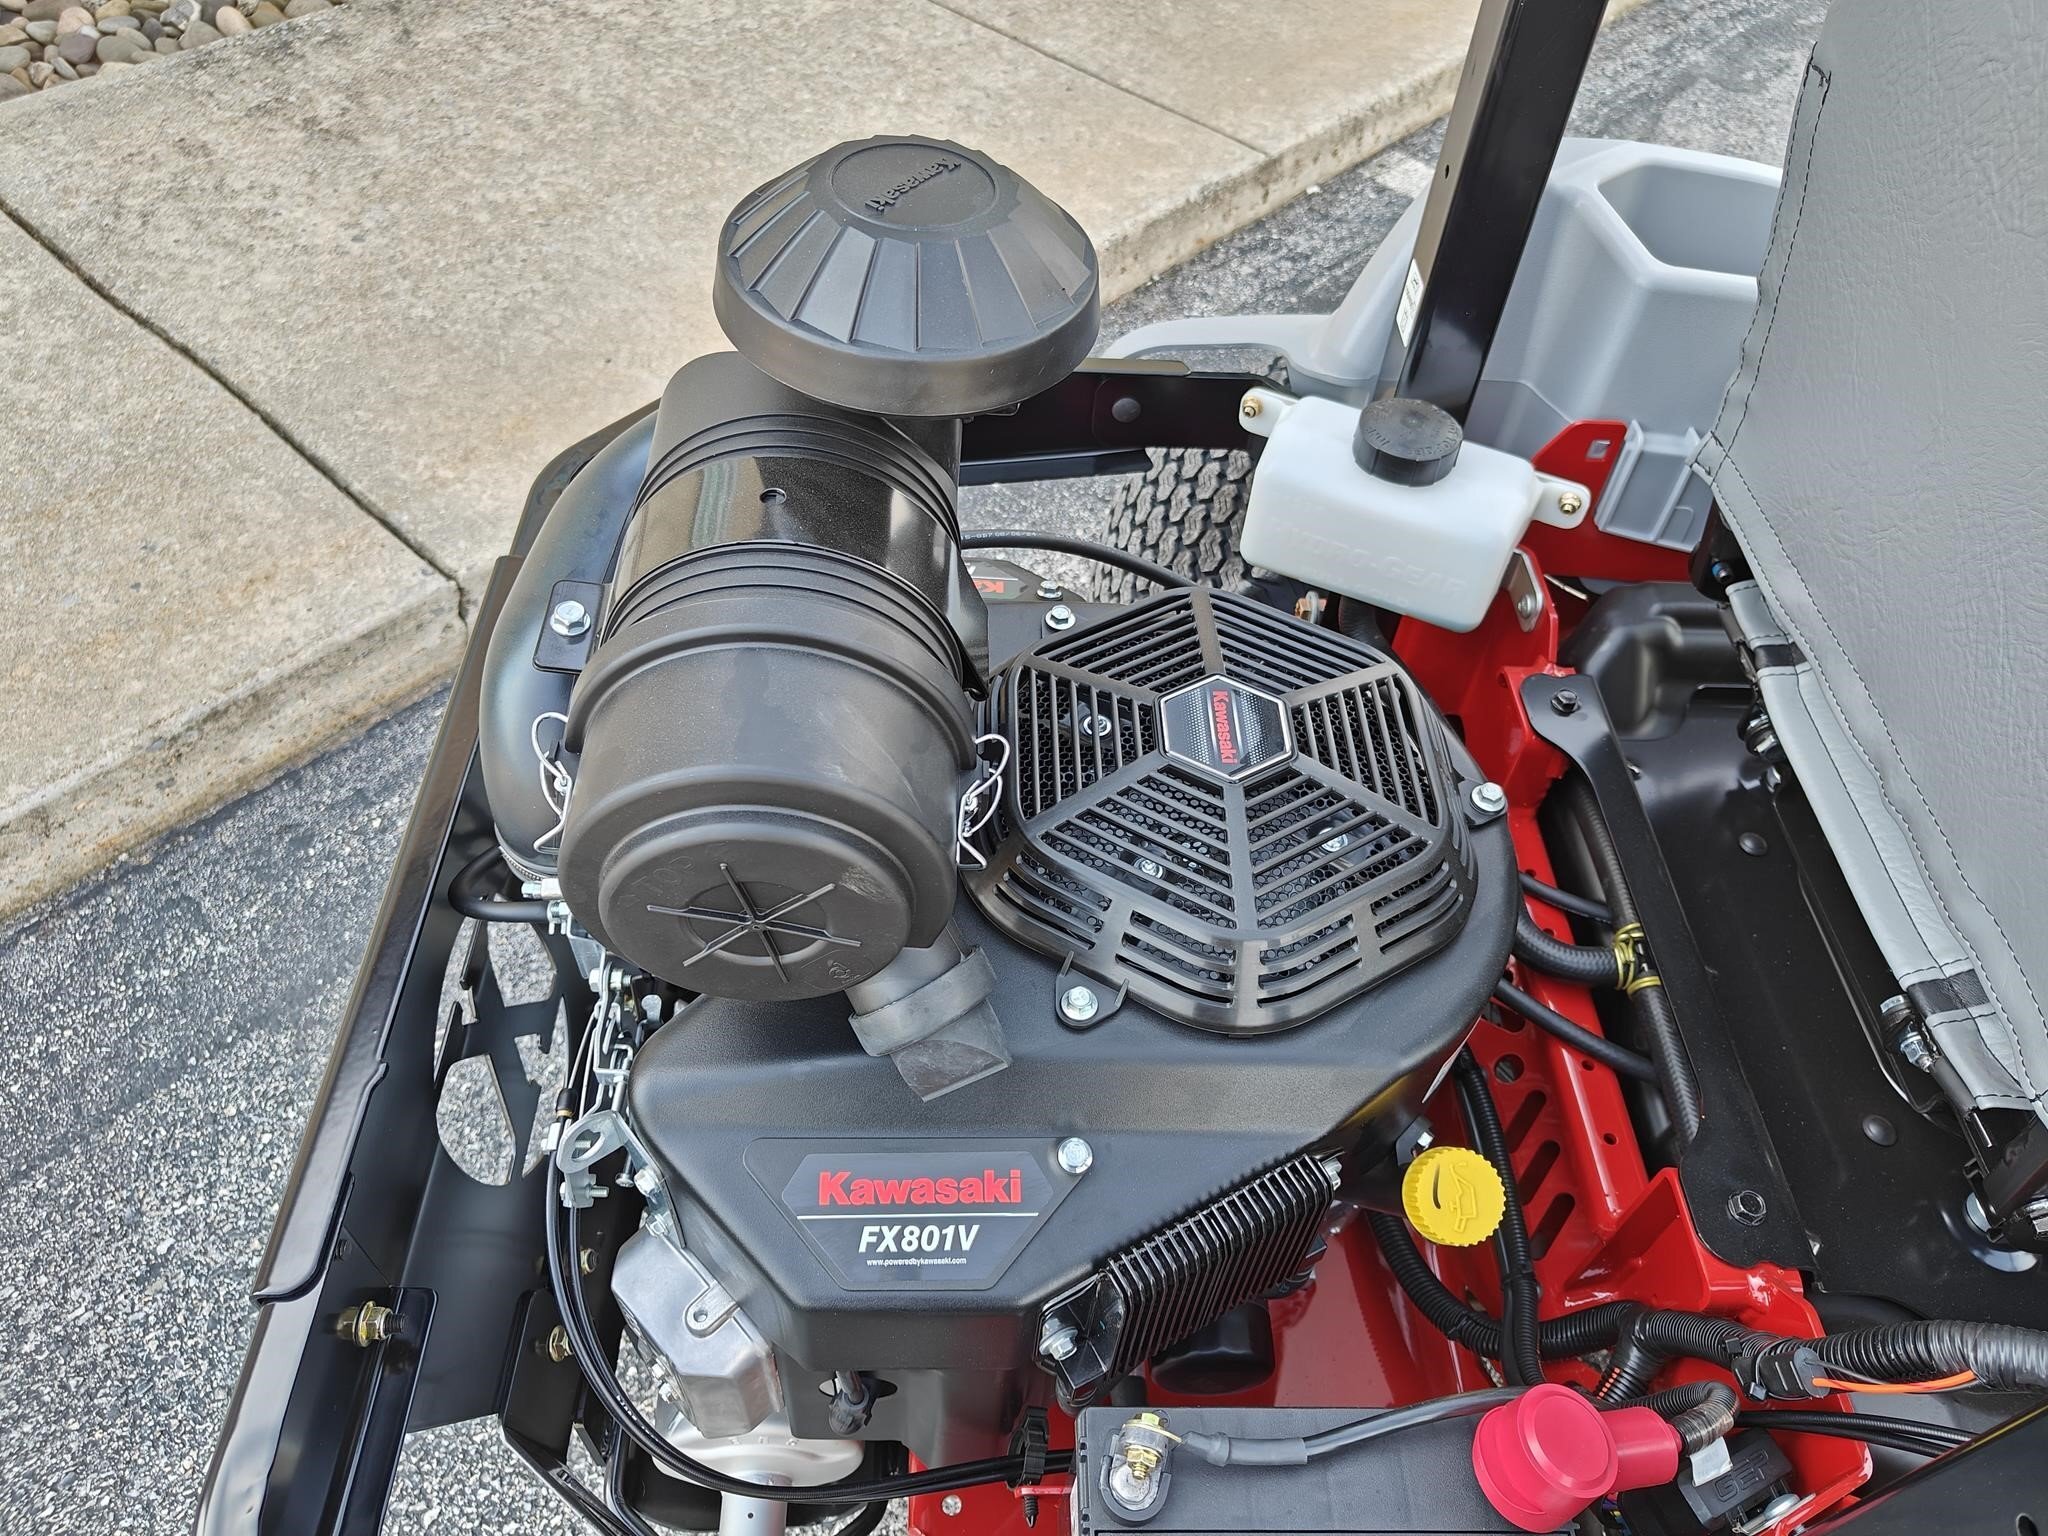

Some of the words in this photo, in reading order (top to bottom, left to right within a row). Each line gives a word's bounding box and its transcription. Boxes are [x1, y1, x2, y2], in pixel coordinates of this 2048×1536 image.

[864, 157, 962, 213] Kawasaki
[1212, 690, 1238, 764] Kawasaki
[818, 1169, 1022, 1206] Kawasaki
[858, 1224, 981, 1254] FX801V
[866, 1256, 967, 1267] www.poweredbykawasaki.com
